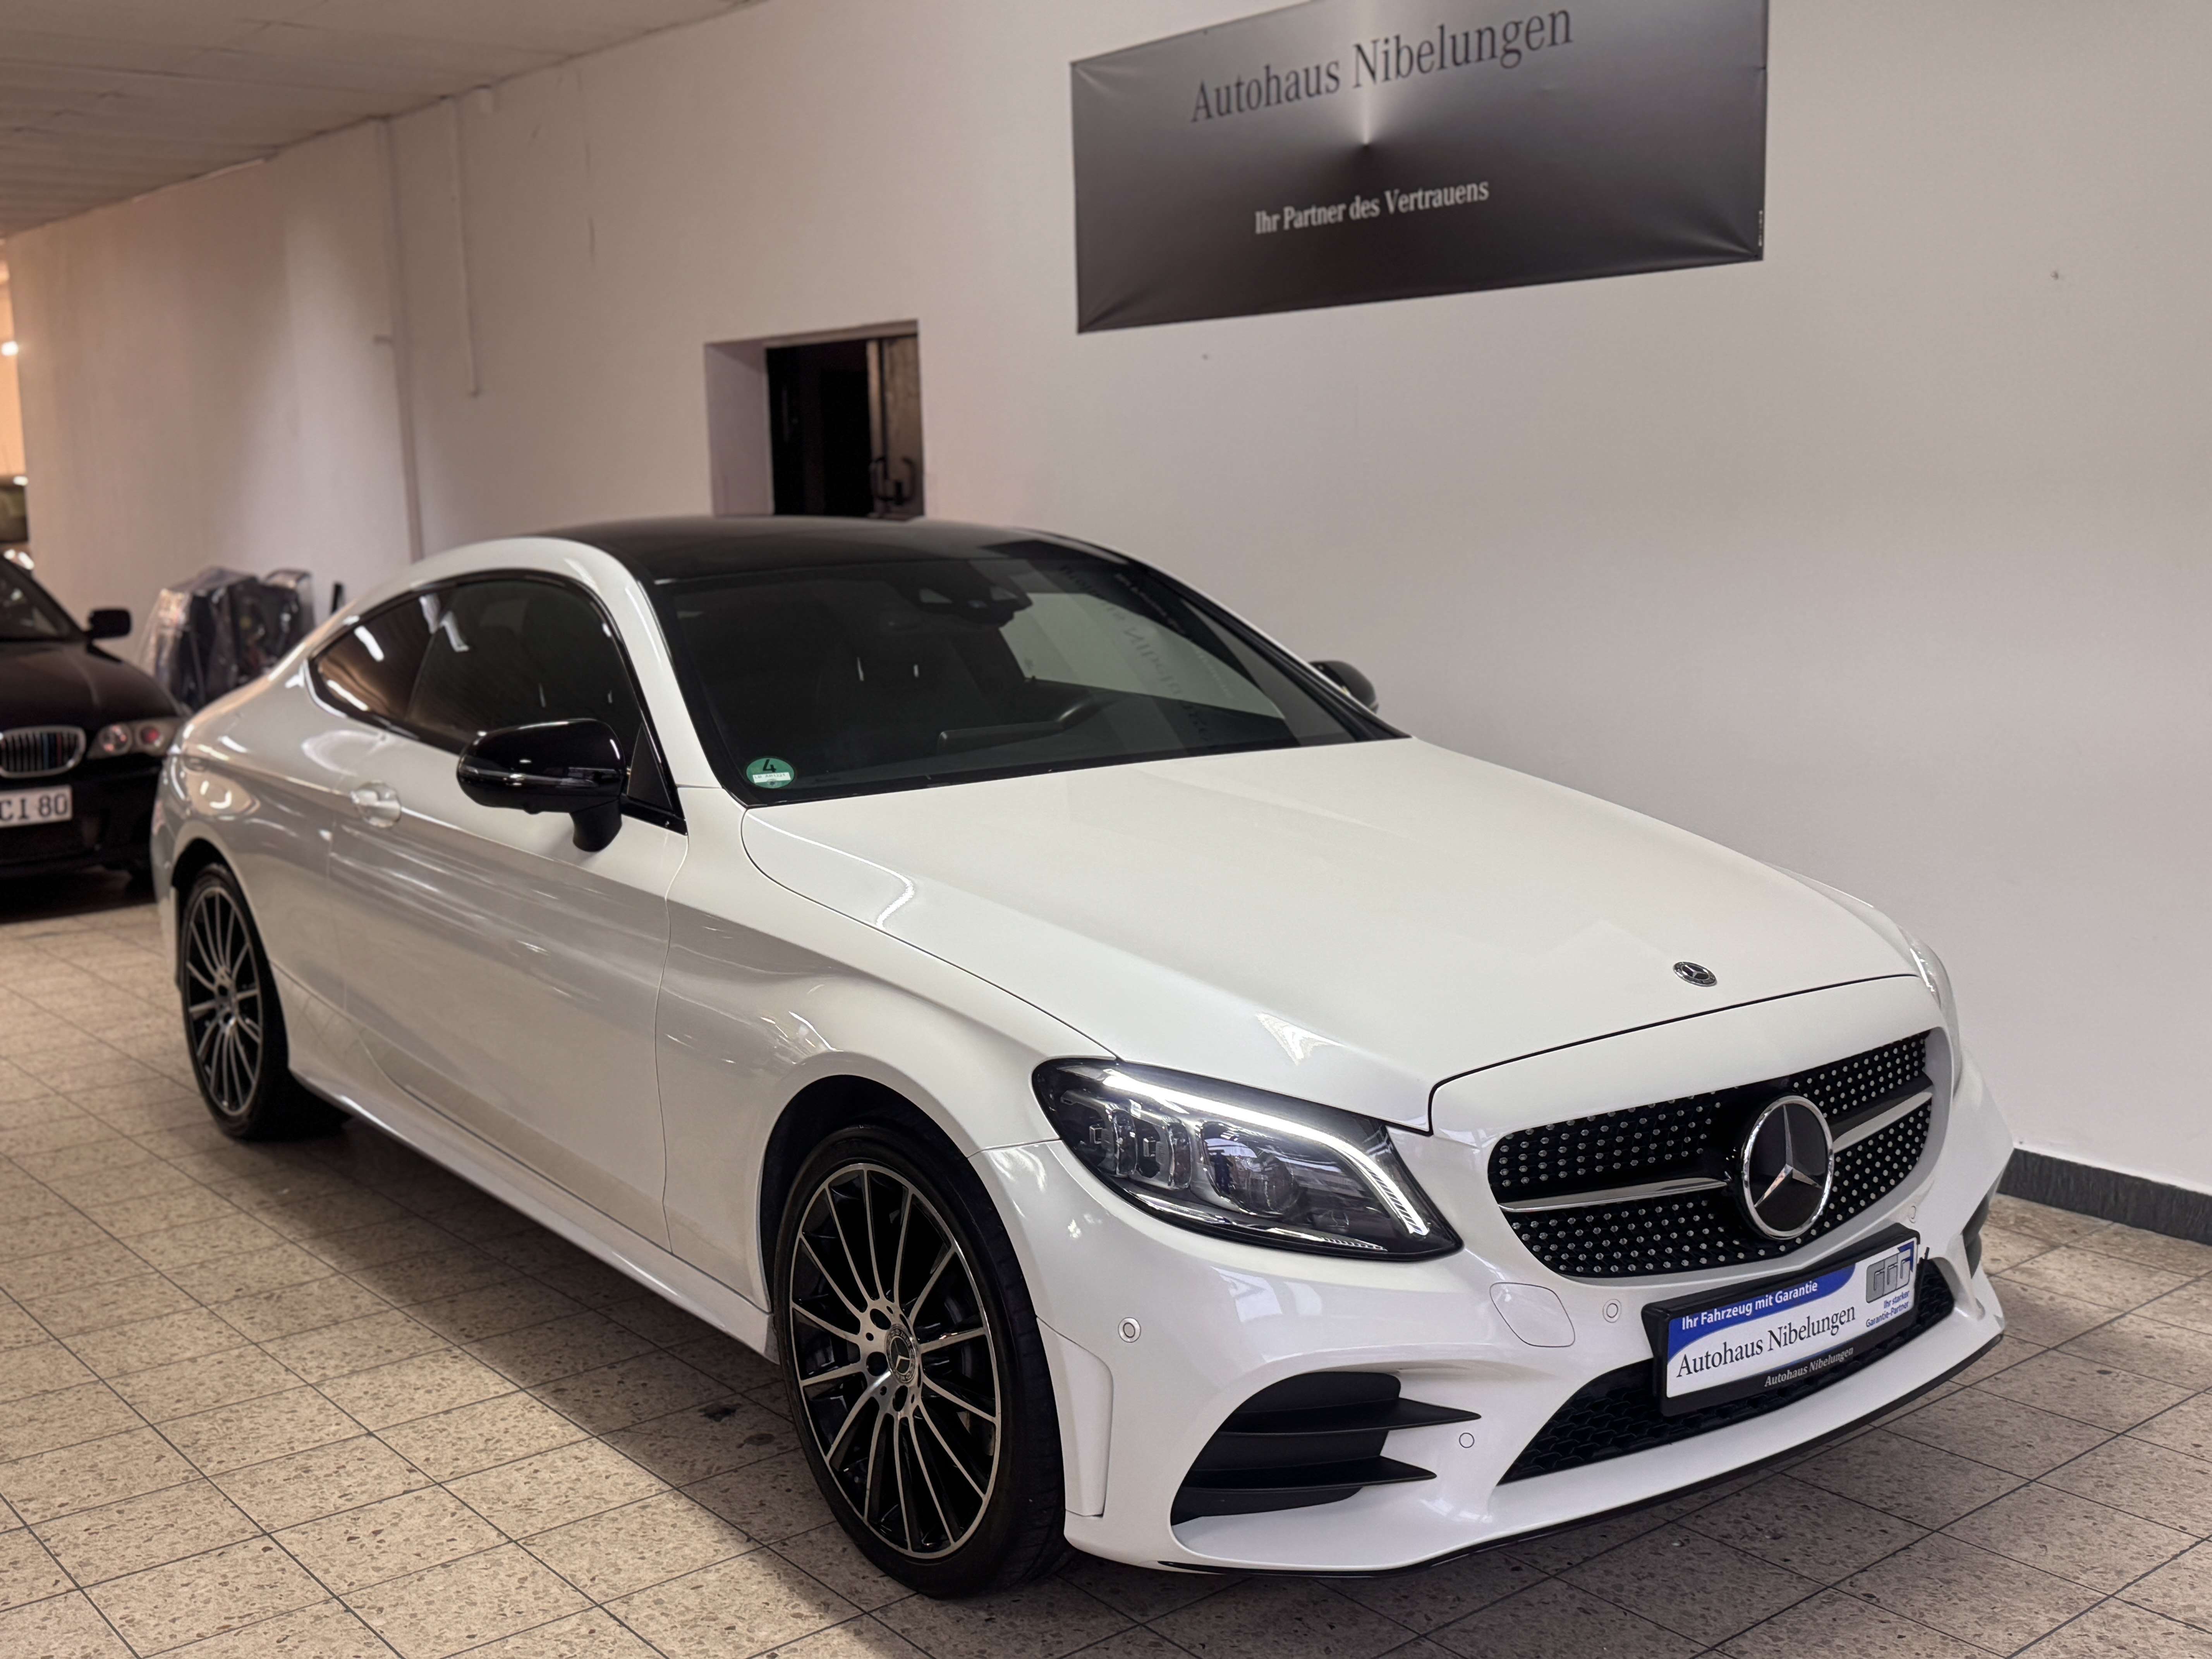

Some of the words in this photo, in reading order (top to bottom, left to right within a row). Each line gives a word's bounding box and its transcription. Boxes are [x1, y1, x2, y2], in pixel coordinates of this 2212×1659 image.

[1191, 60, 1340, 123] Autohaus
[1352, 9, 1573, 89] Nibelungen
[1255, 210, 1281, 234] Ihr
[1283, 204, 1347, 230] Partner
[1349, 194, 1381, 220] des
[1383, 180, 1489, 215] Vertrauens
[763, 759, 776, 772] 4
[38, 793, 68, 817] 80
[1682, 1316, 1698, 1330] Ihr
[1700, 1302, 1753, 1325] Fahrzeug
[1755, 1294, 1773, 1310] mit
[1775, 1280, 1818, 1304] Garantie
[1883, 1299, 1891, 1309] Ihr
[1892, 1290, 1910, 1305] starker
[1676, 1338, 1764, 1377] Autohaus
[1767, 1305, 1856, 1352] Nibelungen
[1764, 1365, 1808, 1387] Autohaus
[1808, 1346, 1854, 1373] Nibelungen
